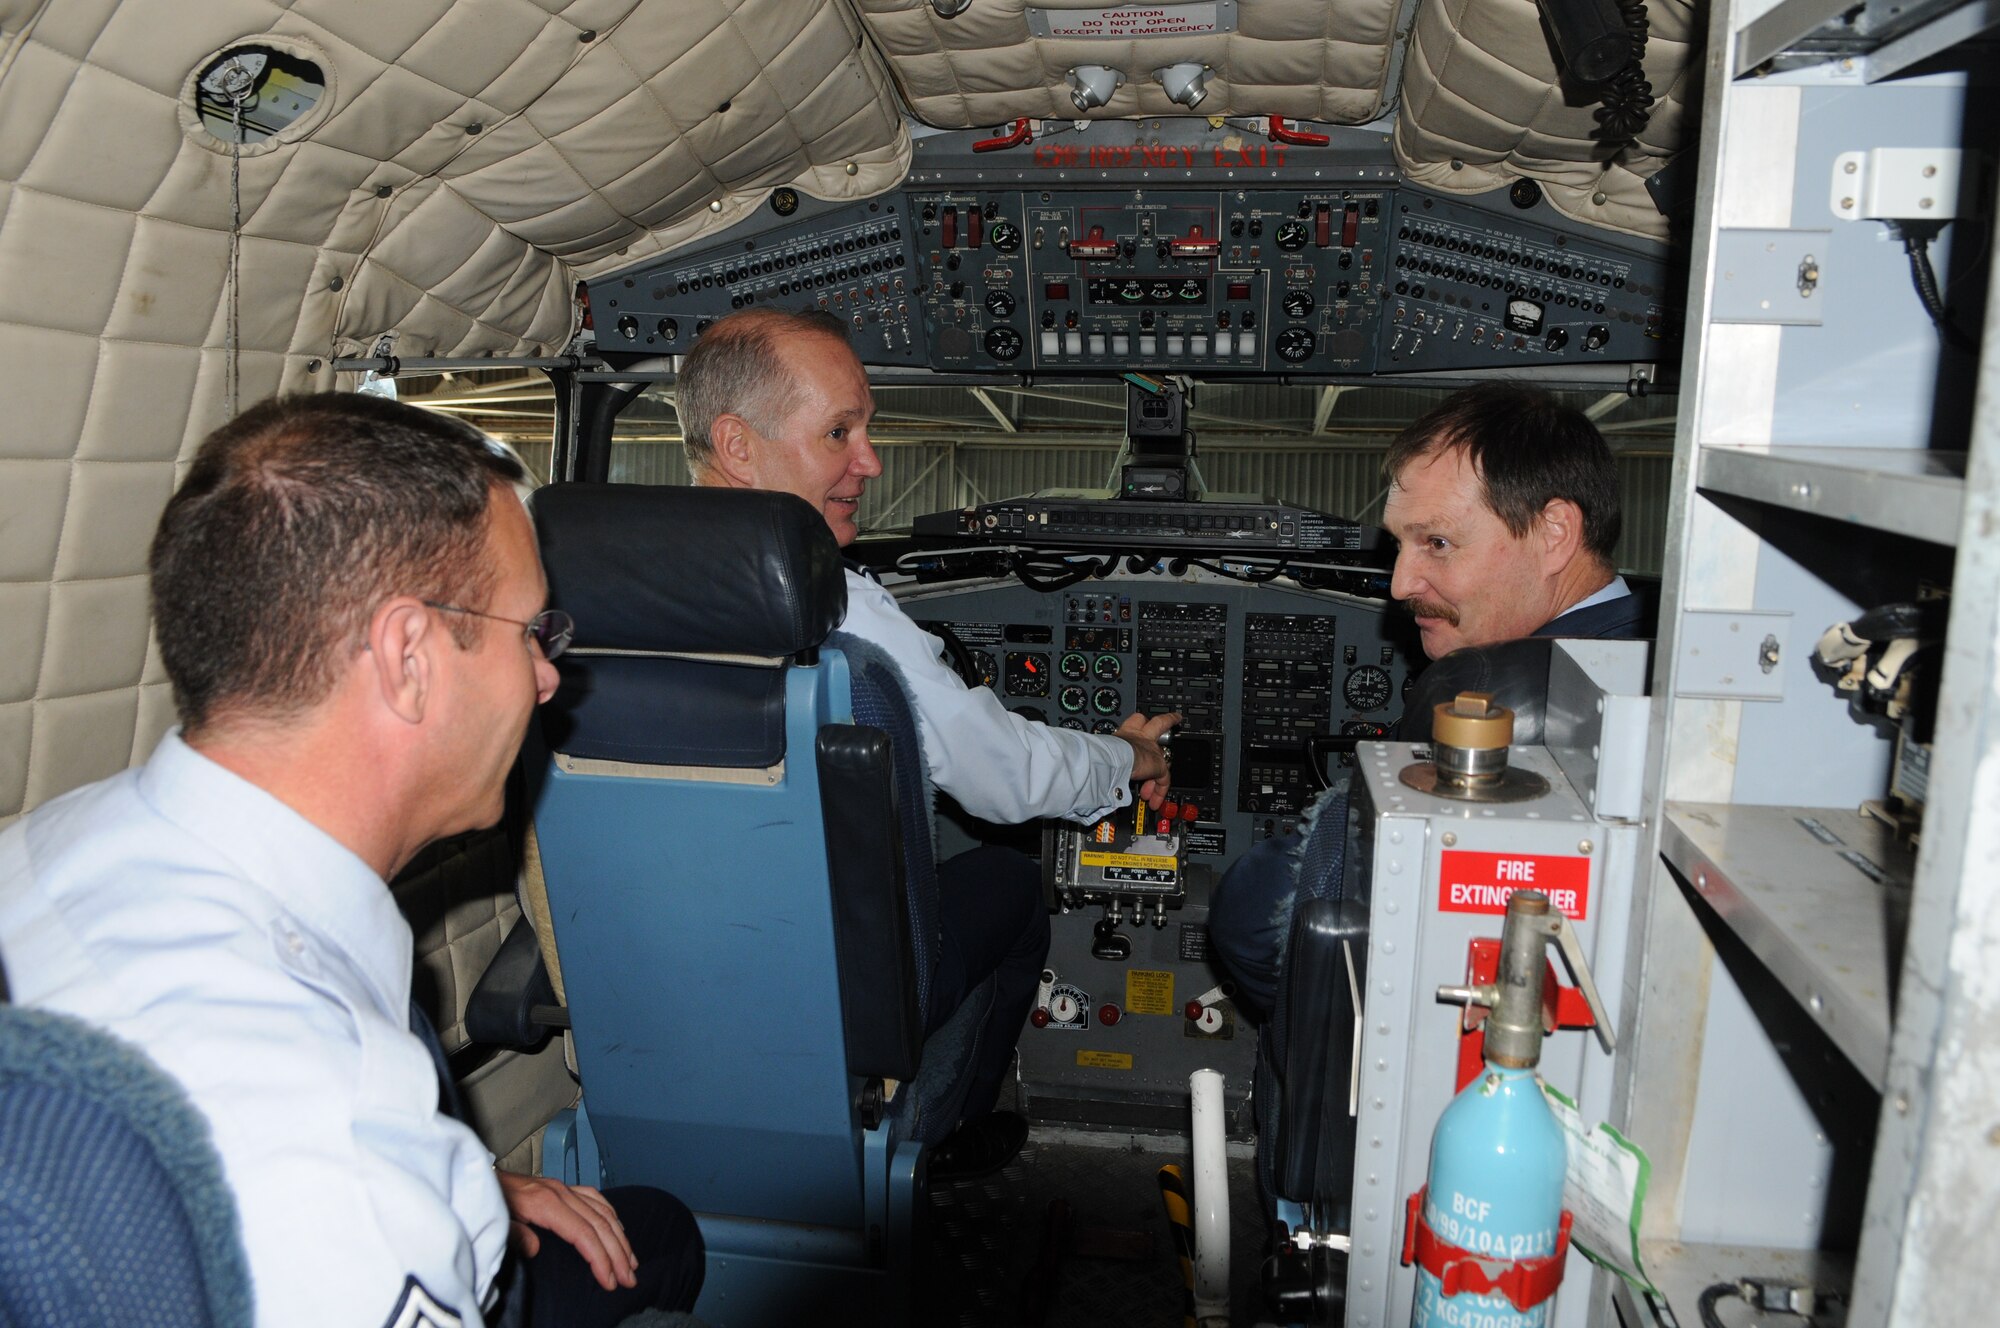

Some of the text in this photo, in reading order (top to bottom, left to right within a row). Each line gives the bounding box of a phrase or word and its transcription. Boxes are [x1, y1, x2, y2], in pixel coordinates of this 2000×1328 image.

[1102, 10, 1164, 19] CAUTION
[1146, 17, 1186, 25] OPEN
[1130, 24, 1214, 34] EMERGENCY
[1033, 144, 1290, 168] EMERGENCY EXIT
[1496, 859, 1535, 882] FIRE
[1452, 1191, 1491, 1223] BCF
